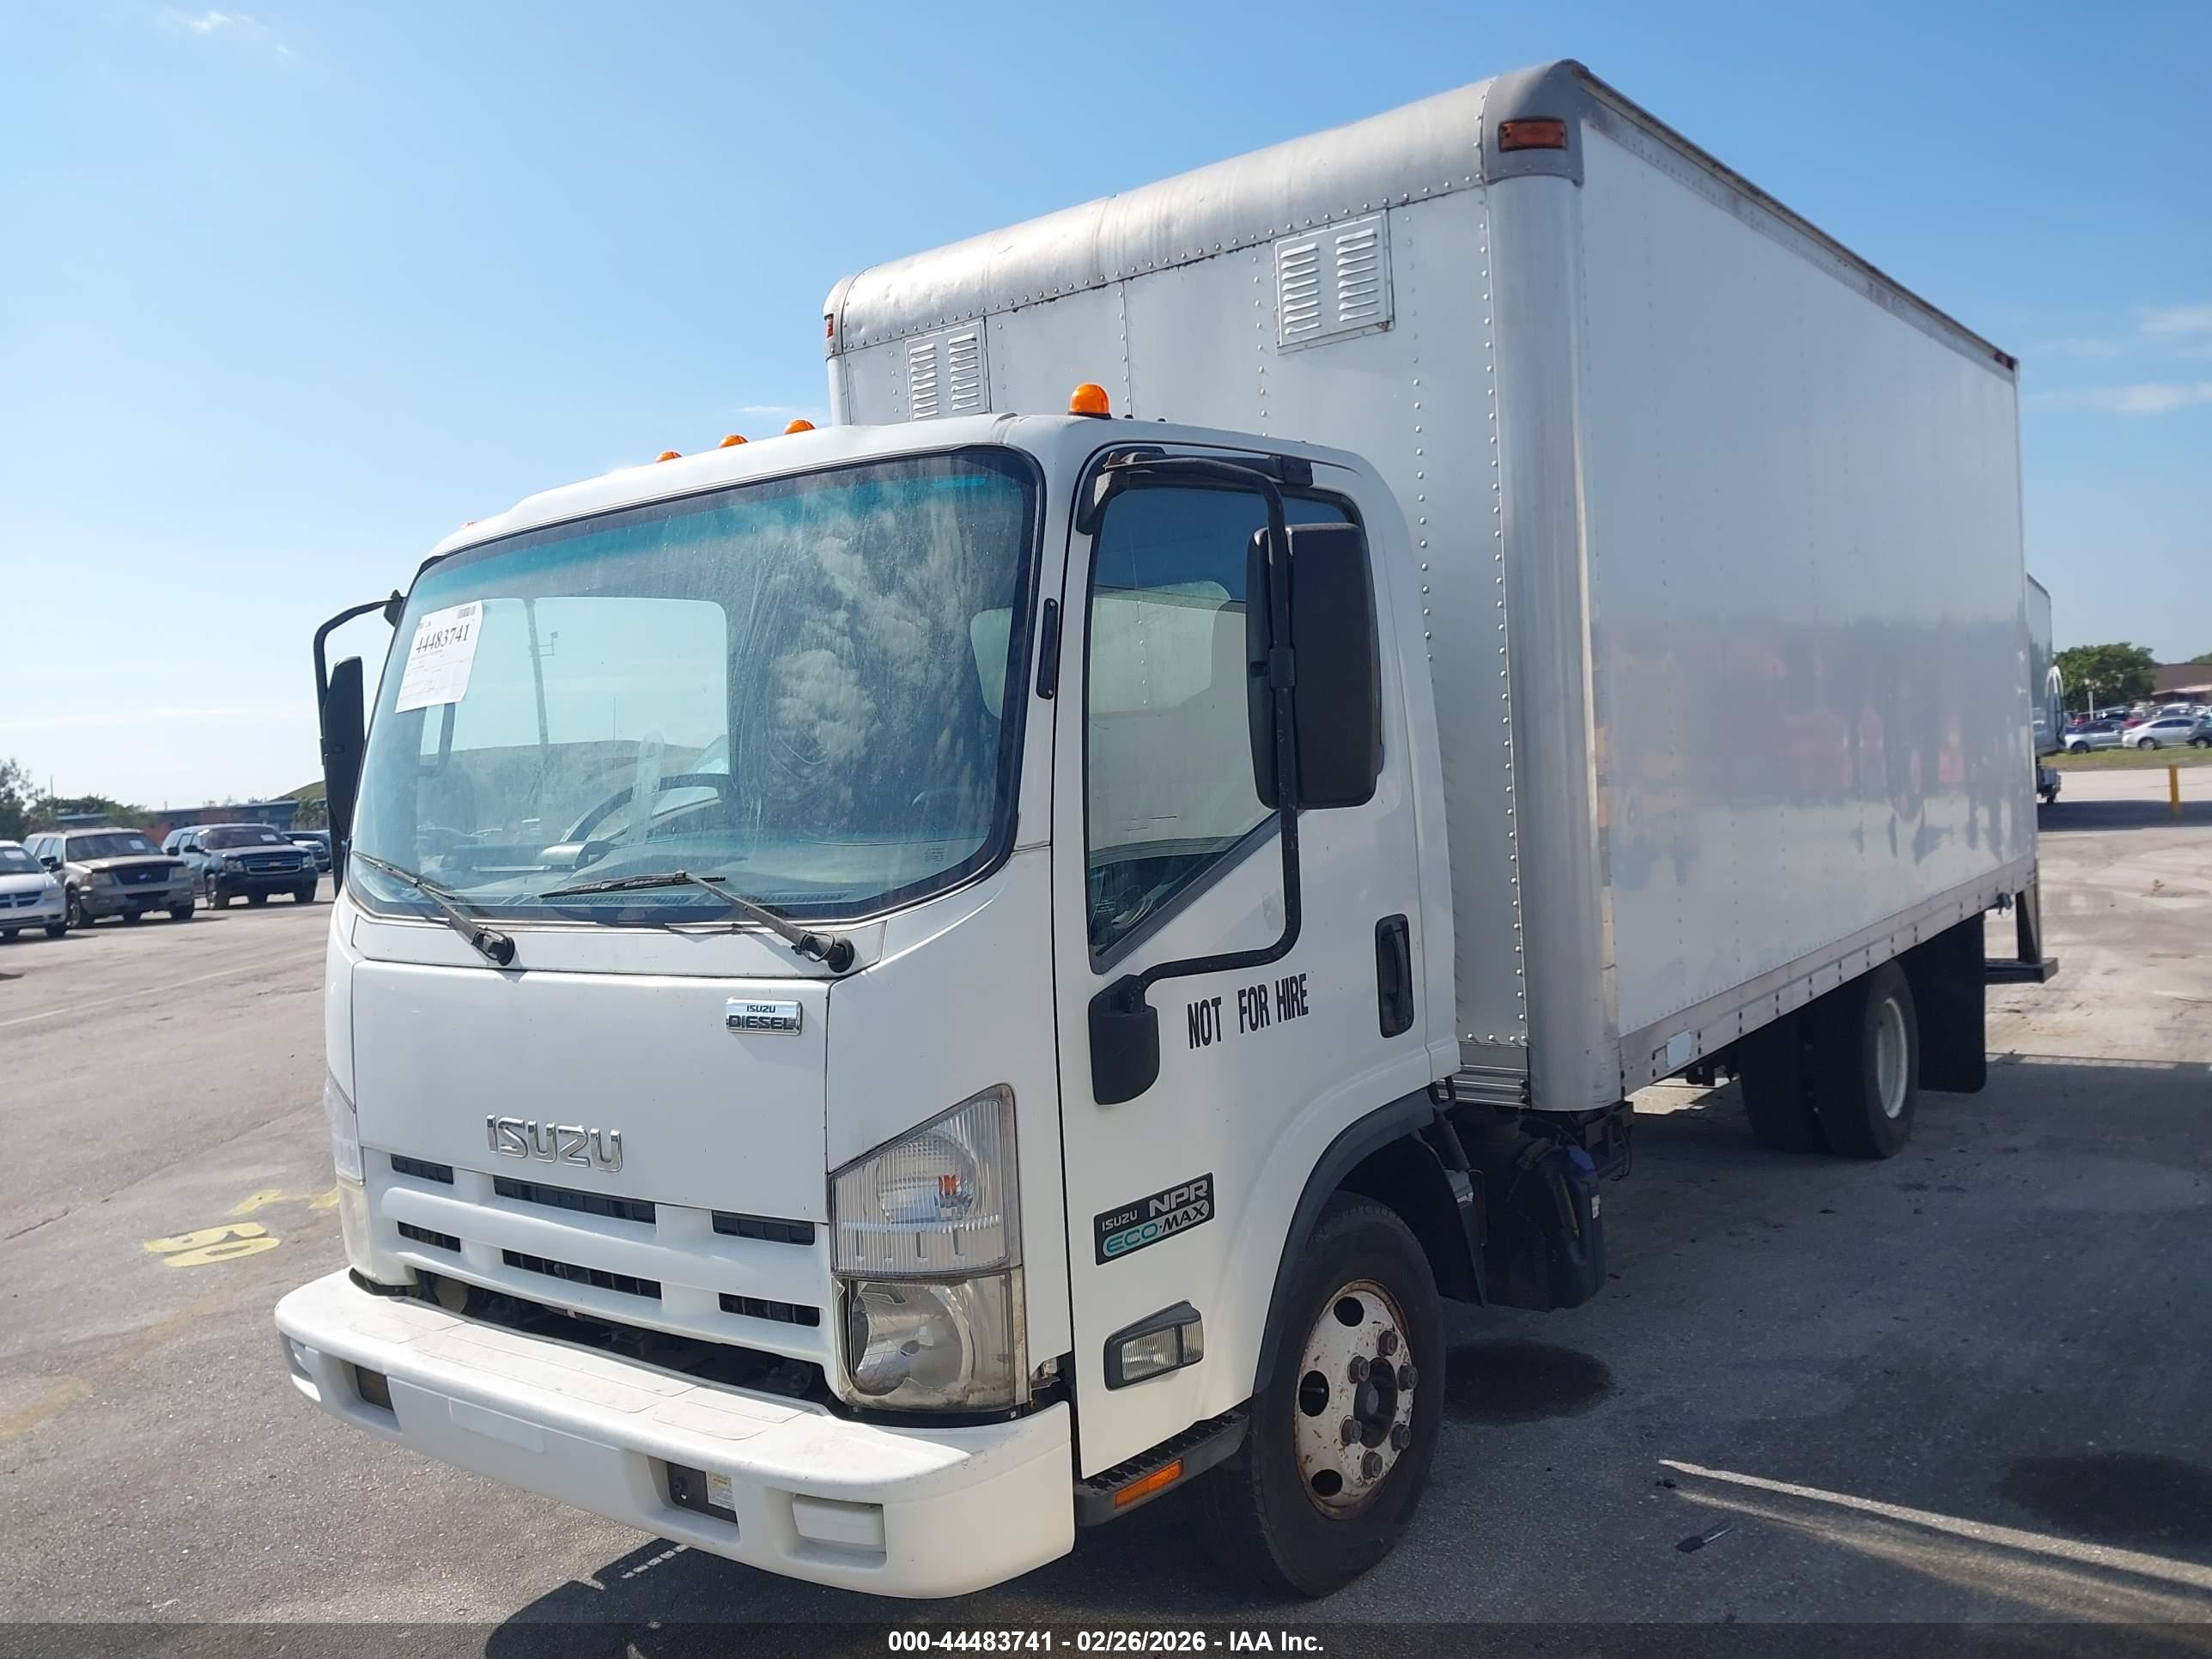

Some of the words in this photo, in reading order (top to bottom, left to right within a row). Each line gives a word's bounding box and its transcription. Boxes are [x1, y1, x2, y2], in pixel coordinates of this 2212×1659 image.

[416, 623, 470, 653] 44483741
[728, 1015, 796, 1030] DIESEL
[746, 1005, 776, 1013] ISUZU
[1187, 996, 1222, 1049] NOT
[1237, 984, 1271, 1034] FOR
[1275, 973, 1309, 1023] HIRE
[486, 1115, 623, 1172] ISUZU
[1102, 1210, 1138, 1231] ISUZU
[1149, 1180, 1208, 1218] NPR
